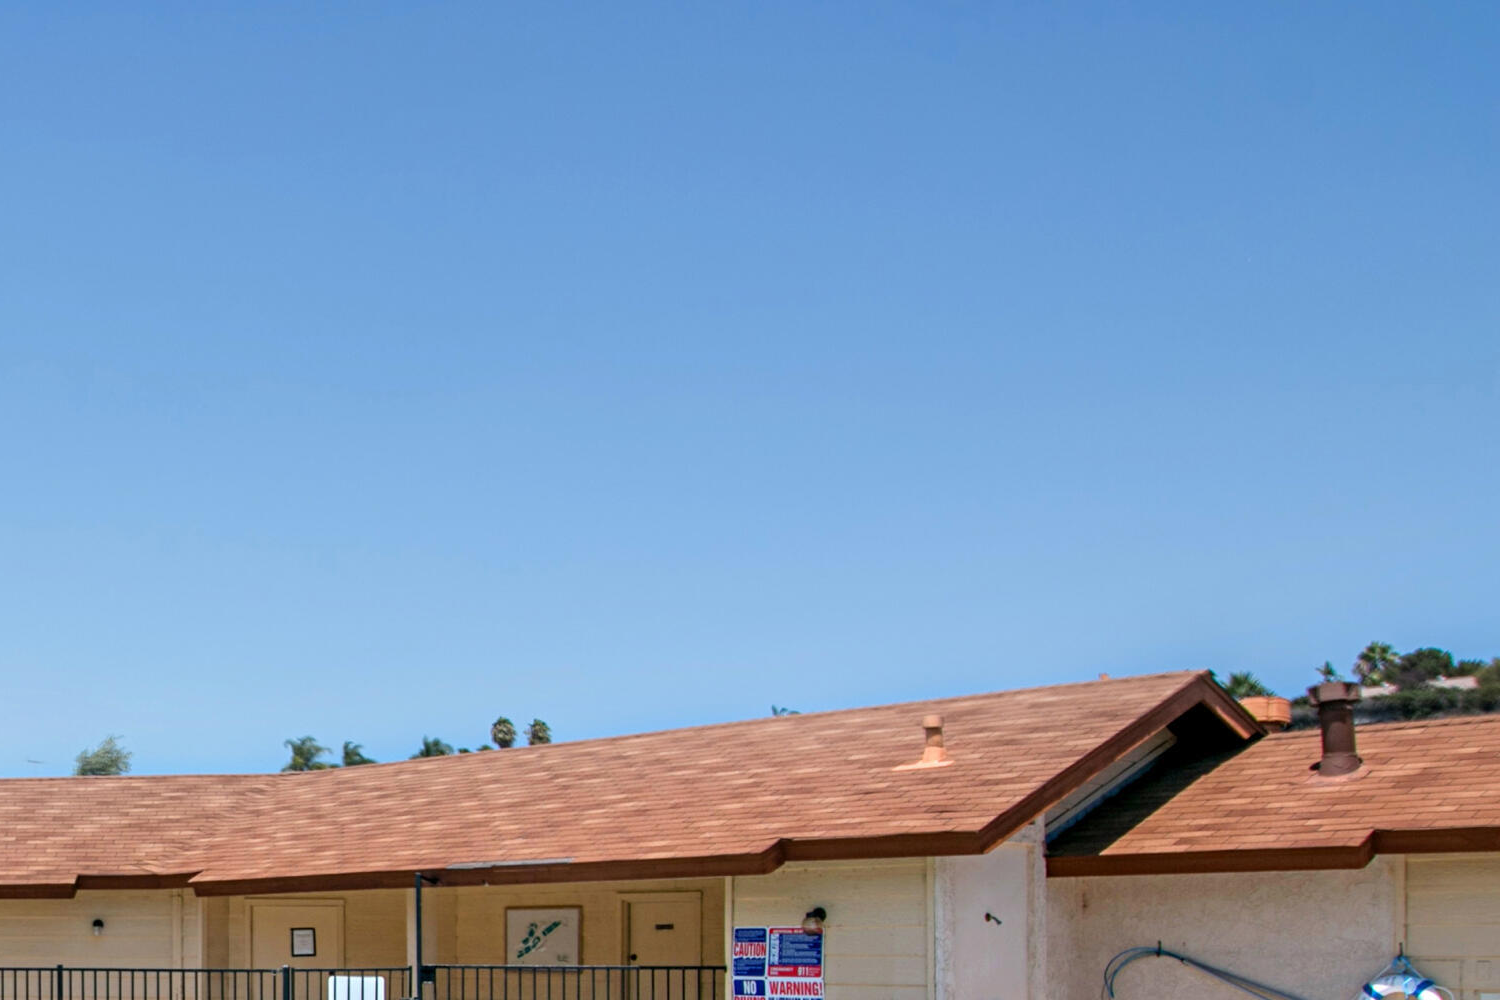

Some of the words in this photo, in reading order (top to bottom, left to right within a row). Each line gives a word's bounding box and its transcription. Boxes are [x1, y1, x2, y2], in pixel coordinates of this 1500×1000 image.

[734, 942, 767, 957] CAUTION
[743, 980, 757, 995] NO
[769, 981, 823, 996] WARNING!
